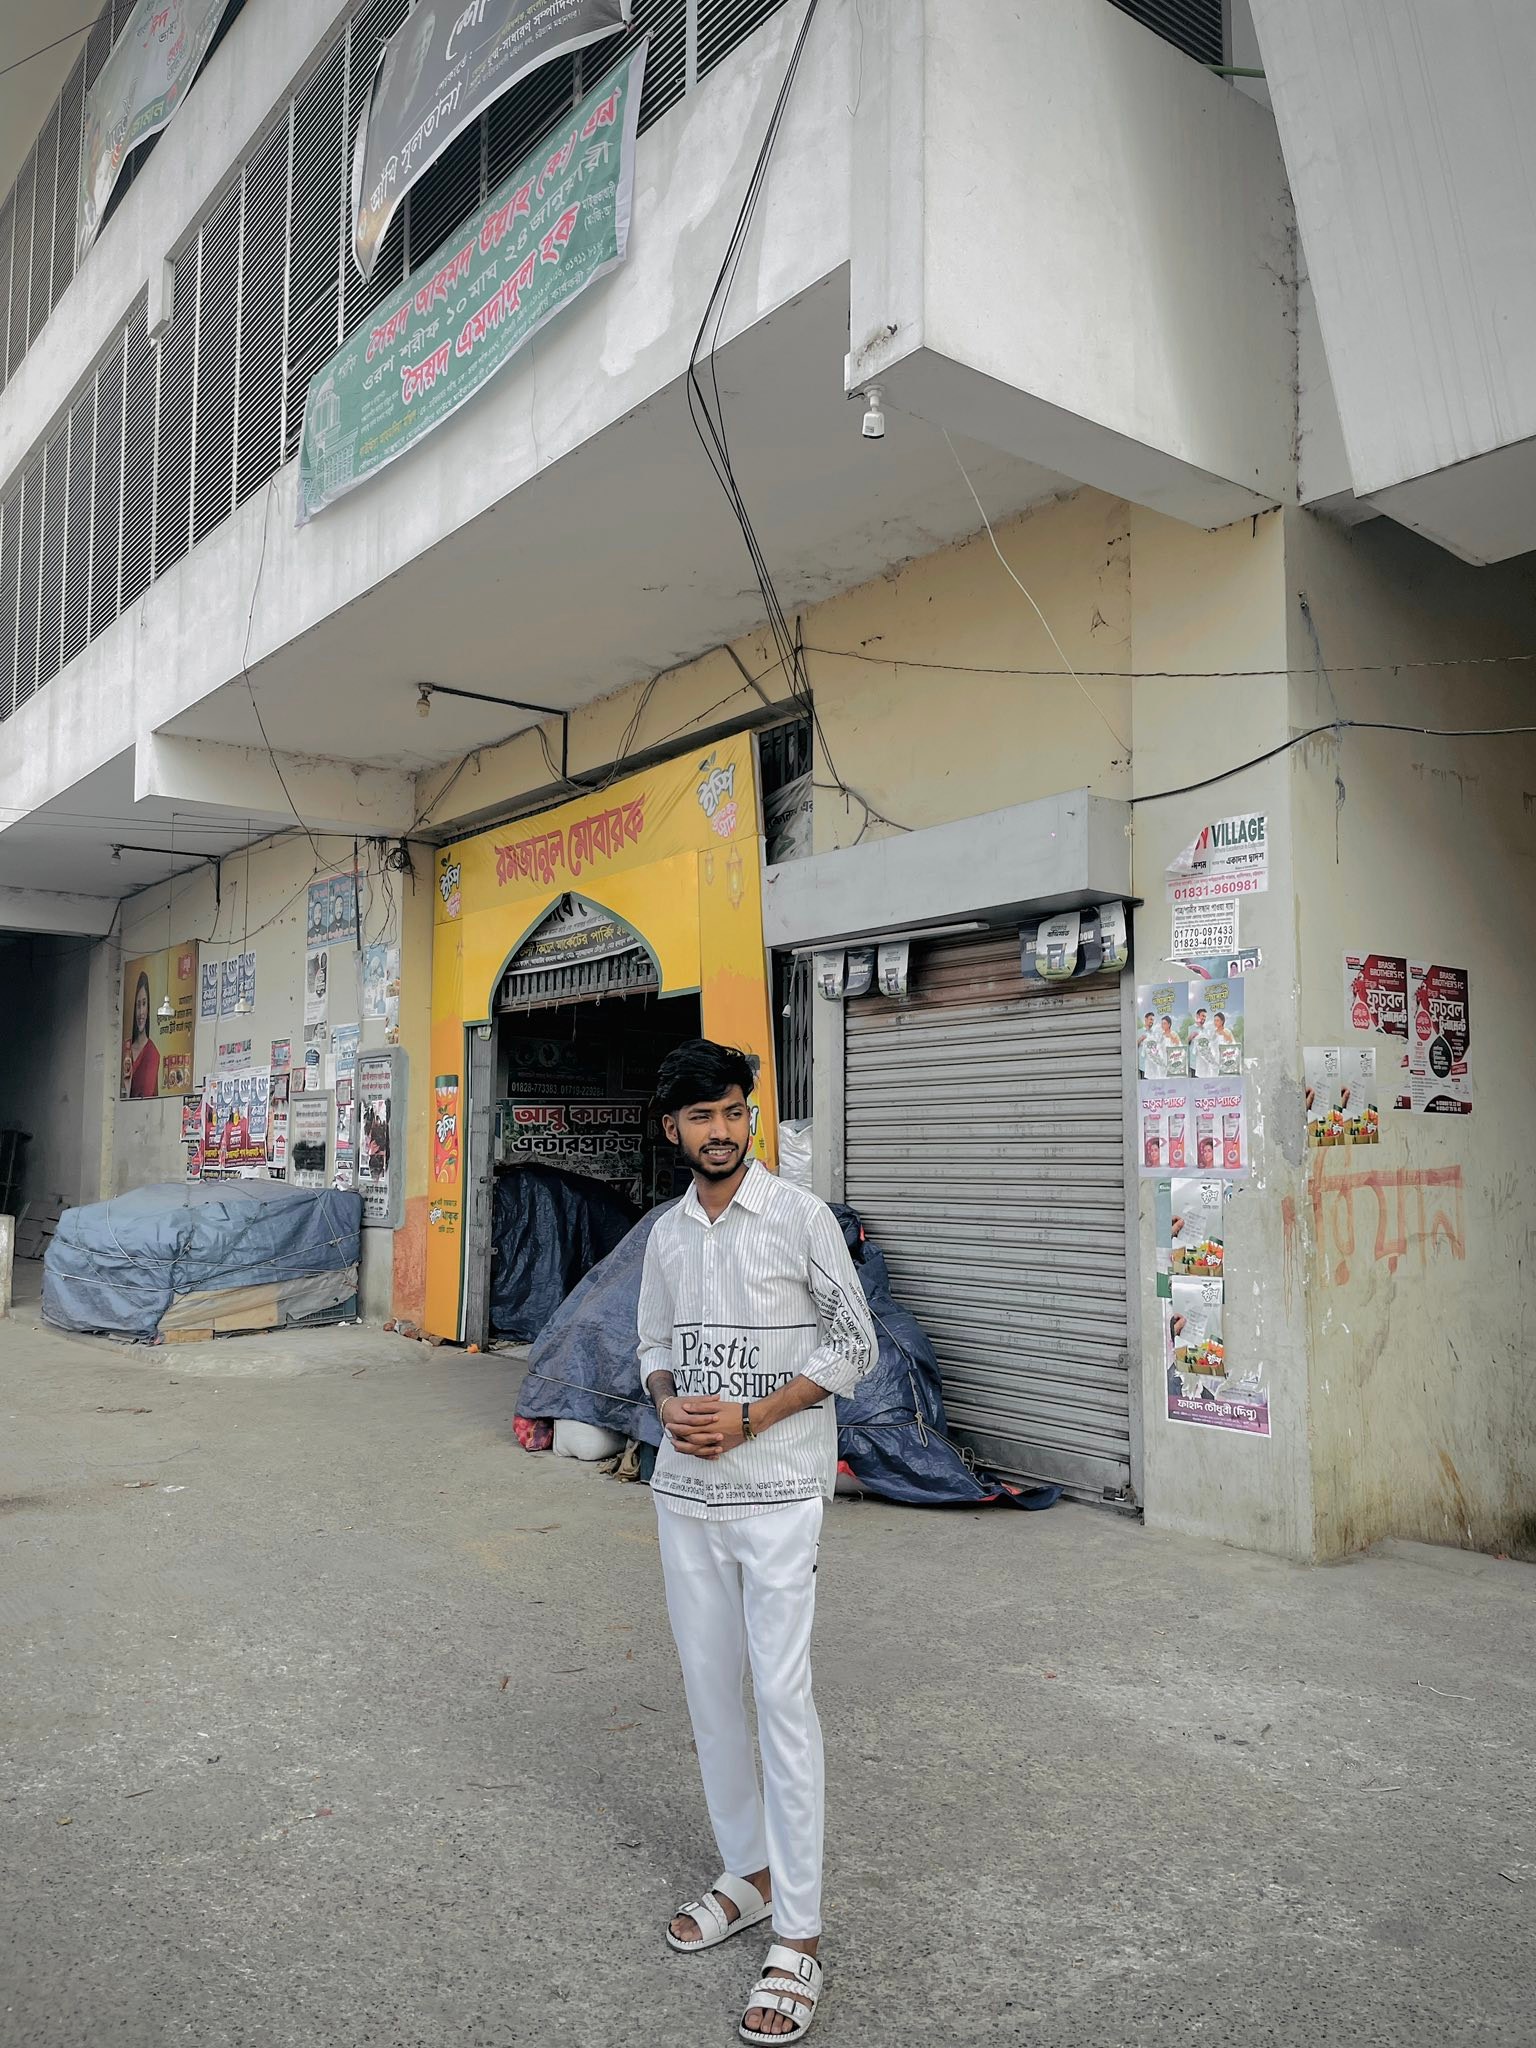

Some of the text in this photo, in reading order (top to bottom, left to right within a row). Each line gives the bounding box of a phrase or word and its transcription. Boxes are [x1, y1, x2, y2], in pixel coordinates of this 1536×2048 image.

[401, 81, 463, 174] সুলতানা
[479, 174, 537, 257] উল্লাহ
[361, 353, 396, 391] ওরশ
[399, 318, 440, 358] শরীফ
[446, 297, 467, 326] ১০
[469, 262, 498, 297] মাঘ
[505, 234, 529, 263] ২৪
[399, 337, 453, 405] সৈয়দ
[454, 249, 538, 357] এমদাদুল
[539, 201, 581, 265] হক
[495, 797, 646, 888] রমজানুল মোবারক
[1211, 816, 1265, 848] VILLAGE
[1248, 851, 1264, 864] দ্বাদশ
[1174, 879, 1259, 900] 01831-960981
[1174, 925, 1233, 939] 01770-097433
[1174, 936, 1233, 949] 01823-401970
[1365, 985, 1405, 1014] ফুটবল
[1428, 994, 1464, 1022] ফুটবল
[1142, 1095, 1187, 1112] নতুন প্যাকে
[1194, 1094, 1241, 1112] নতুন প্যাকে
[512, 1105, 642, 1133] আবু কালাম
[512, 1130, 643, 1158] এন্টারপ্রাইজ
[1177, 1398, 1204, 1411] ফাহাদ
[1204, 1401, 1232, 1417] চৌধুরী
[1233, 1405, 1257, 1421] (দিপু)
